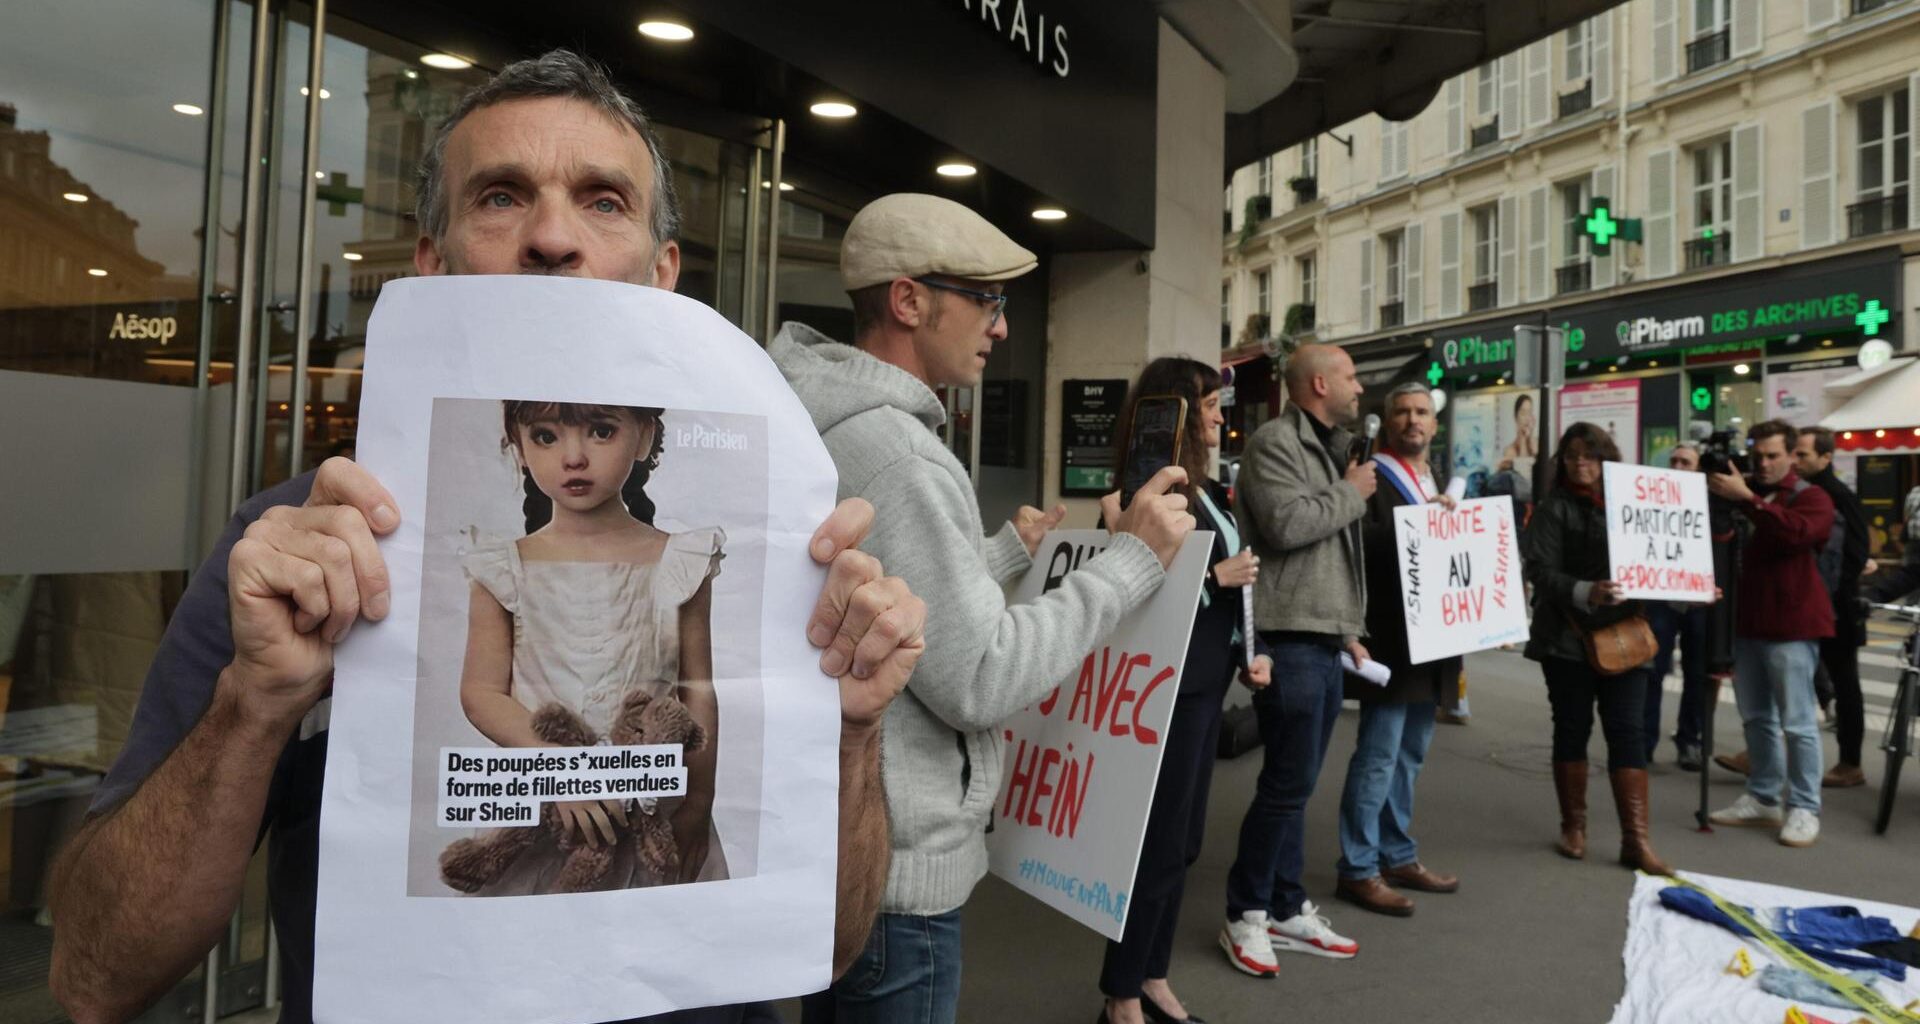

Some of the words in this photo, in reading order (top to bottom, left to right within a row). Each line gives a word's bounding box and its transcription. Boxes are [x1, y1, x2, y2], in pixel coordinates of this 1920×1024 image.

[964, 0, 1070, 77] RAIS
[109, 312, 177, 345] Aēsop
[1711, 310, 1749, 333] DES
[1753, 293, 1860, 327] ARCHIVES
[1084, 386, 1104, 396] BHV
[677, 428, 691, 448] Le
[693, 424, 748, 450] Parisien
[1427, 504, 1485, 540] HONTE
[1622, 504, 1704, 539] PARTICIPE
[1665, 541, 1683, 561] LA
[1449, 551, 1471, 588] AU
[1441, 585, 1485, 626] BHV
[1068, 646, 1175, 745] AVEC
[448, 752, 484, 773] Des
[487, 752, 566, 776] poupées
[654, 753, 676, 768] en
[447, 777, 502, 798] forme
[506, 777, 529, 797] de
[532, 774, 602, 796] fillettes
[605, 774, 680, 794] vendues
[1003, 730, 1094, 839] HEIN
[445, 804, 476, 822] sur
[479, 802, 532, 821] Shein
